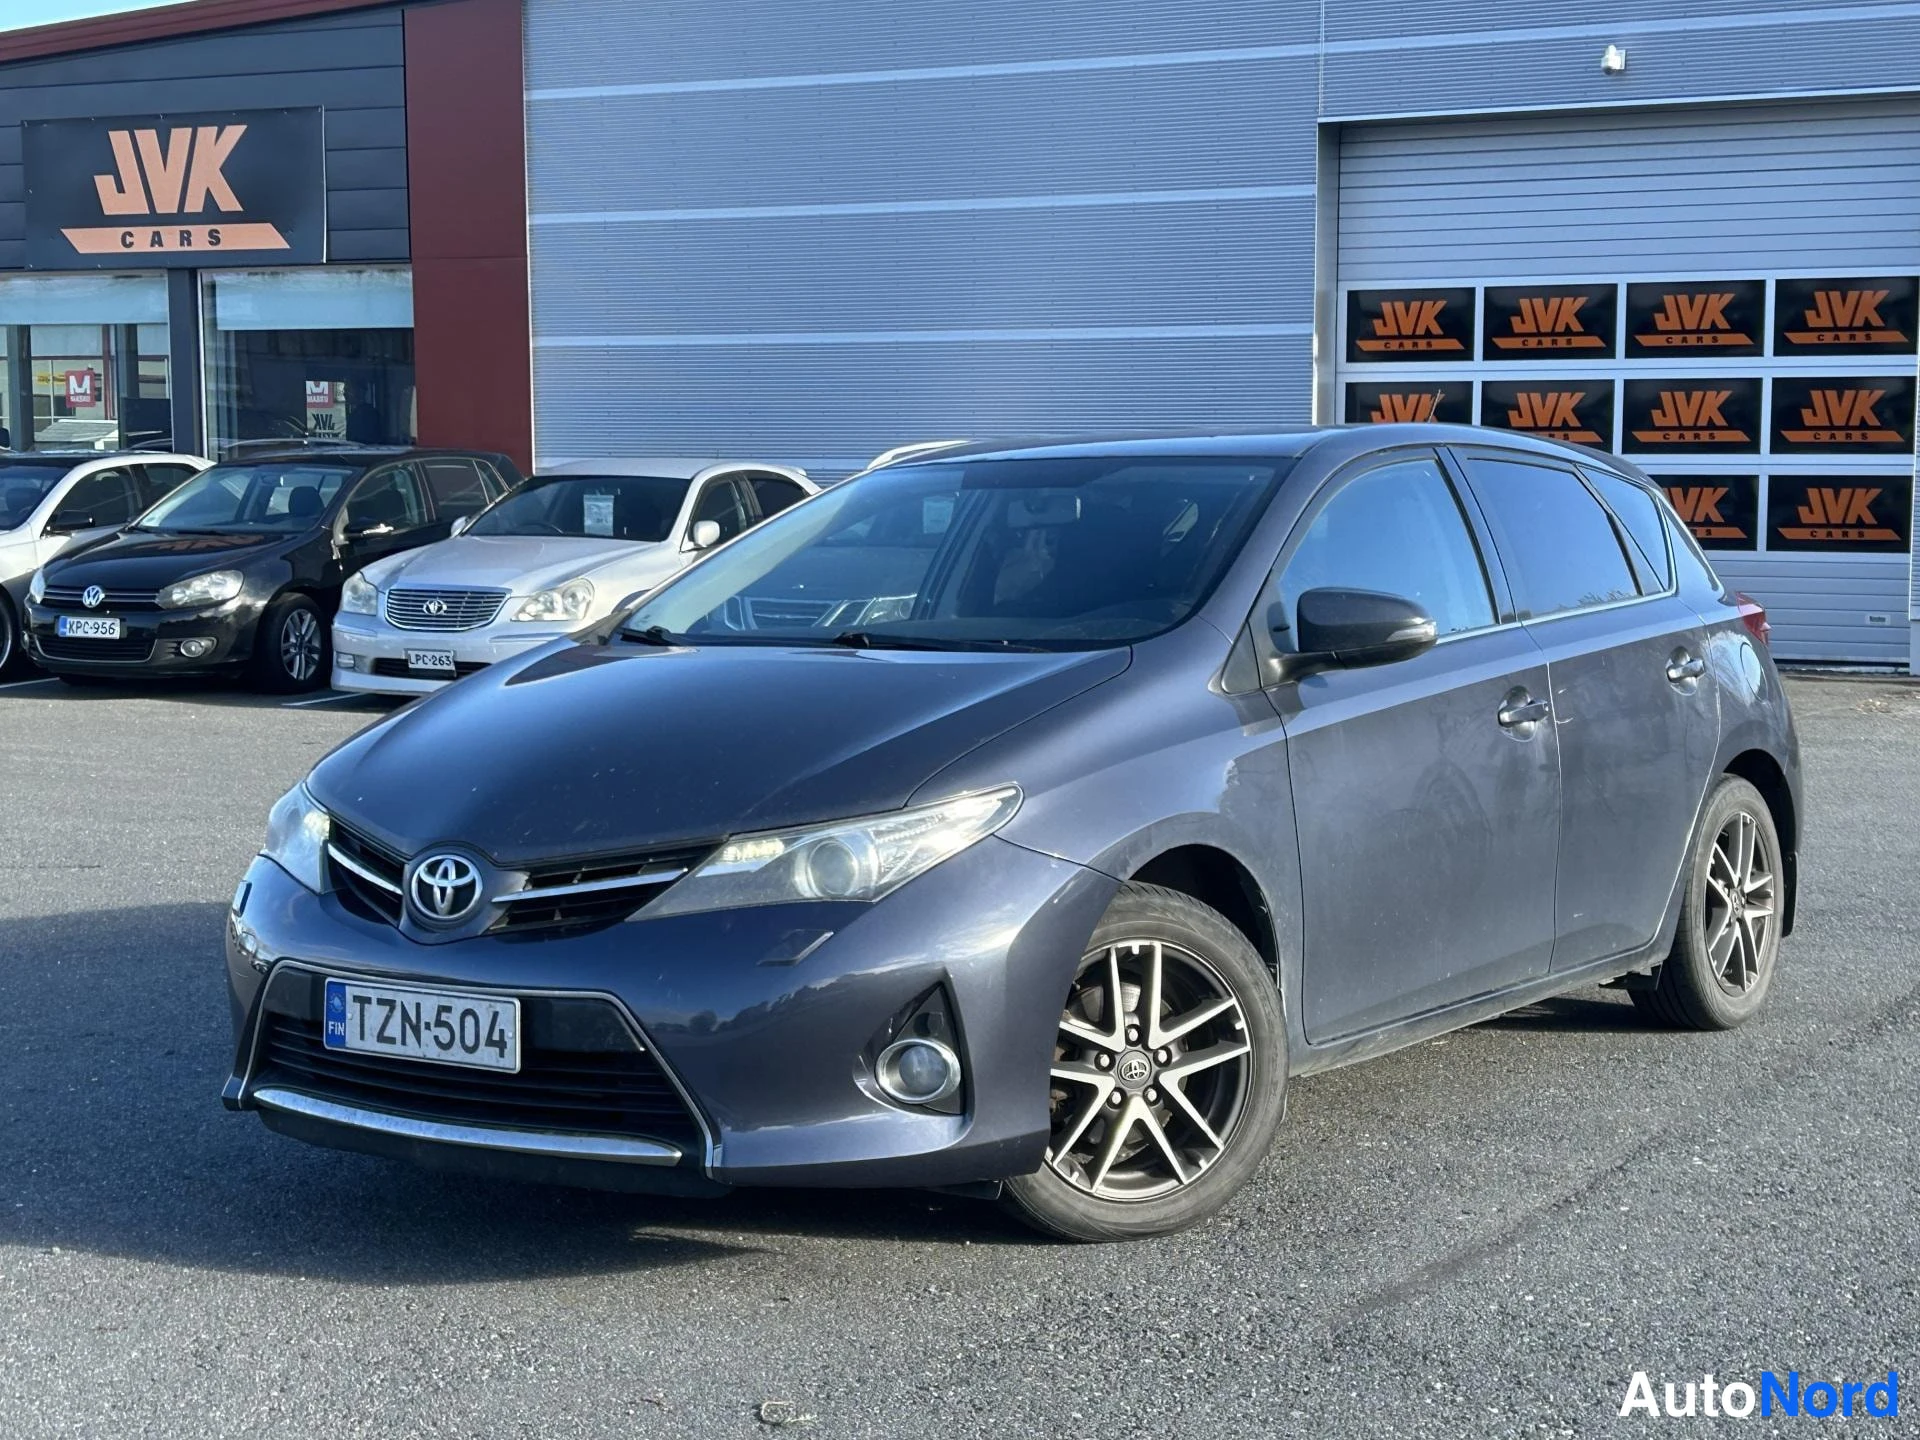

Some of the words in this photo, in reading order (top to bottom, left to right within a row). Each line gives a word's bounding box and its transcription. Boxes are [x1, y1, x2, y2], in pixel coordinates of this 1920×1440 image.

[94, 124, 248, 215] JVK
[120, 228, 222, 248] CARS
[1372, 300, 1447, 336] JVK
[1509, 297, 1589, 333] JVK
[1654, 293, 1736, 331] JVK
[1804, 290, 1890, 328] JVK
[1384, 340, 1433, 349] CARS
[1521, 338, 1573, 346] CARS
[1665, 335, 1719, 344] CARS
[1817, 333, 1873, 342] CARS
[1370, 393, 1446, 424] JVK
[1507, 392, 1587, 427] JVK
[1651, 390, 1734, 427] JVK
[1800, 389, 1886, 427] JVK
[1662, 432, 1716, 441] CARS
[1813, 431, 1869, 441] CARS
[1663, 487, 1729, 523] VK
[1798, 488, 1883, 524] JVK
[1810, 530, 1865, 538] CARS
[68, 620, 117, 635] KPC-956
[409, 653, 452, 666] LPC-263
[328, 1021, 345, 1036] FIN
[352, 995, 508, 1058] TZN-504
